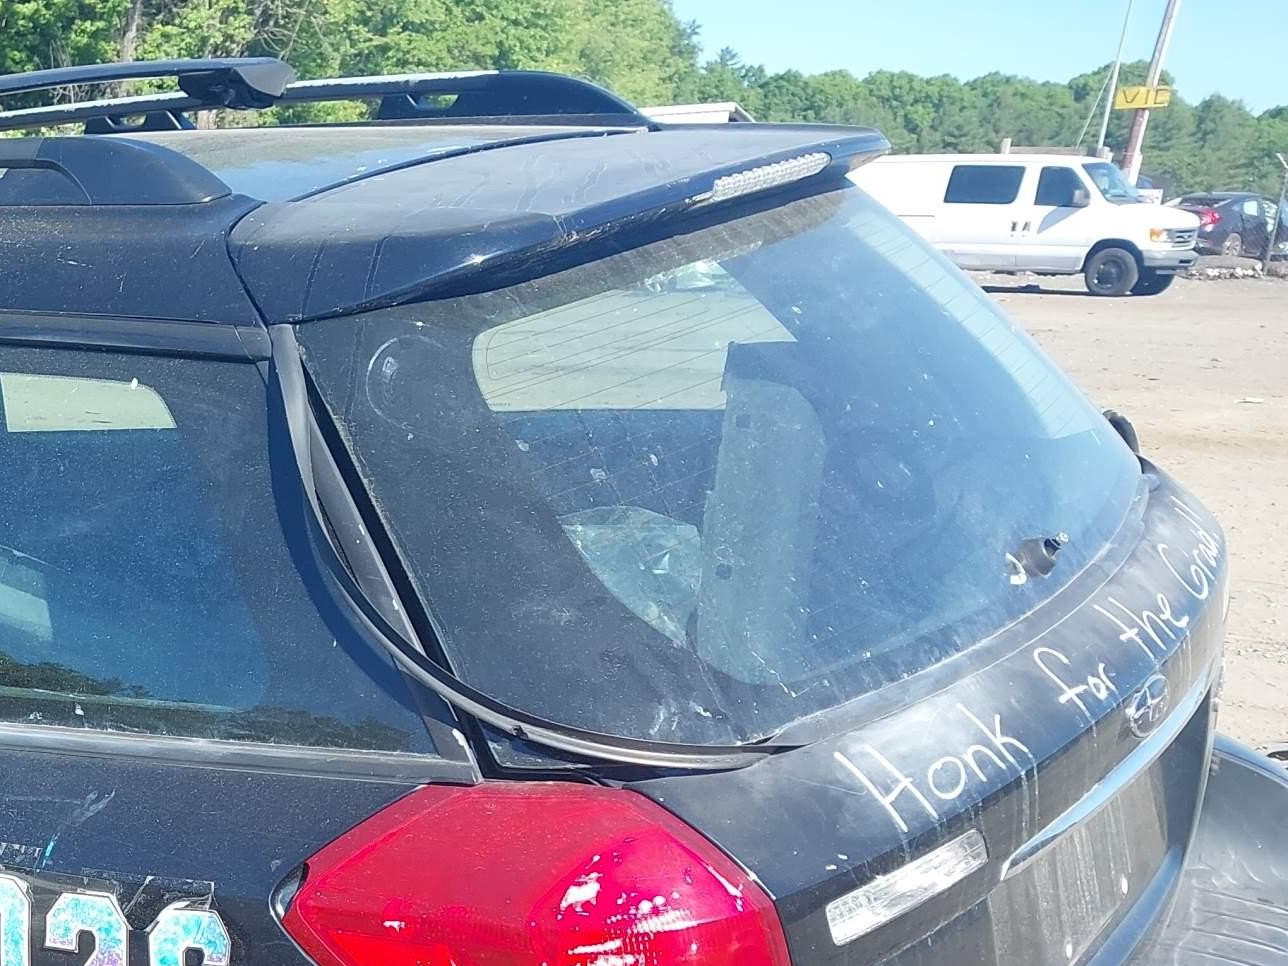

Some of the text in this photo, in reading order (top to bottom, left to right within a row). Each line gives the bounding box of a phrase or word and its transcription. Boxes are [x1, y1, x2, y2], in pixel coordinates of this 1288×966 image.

[832, 703, 1030, 833] Honk
[1033, 647, 1119, 712] for
[1094, 592, 1190, 664] the
